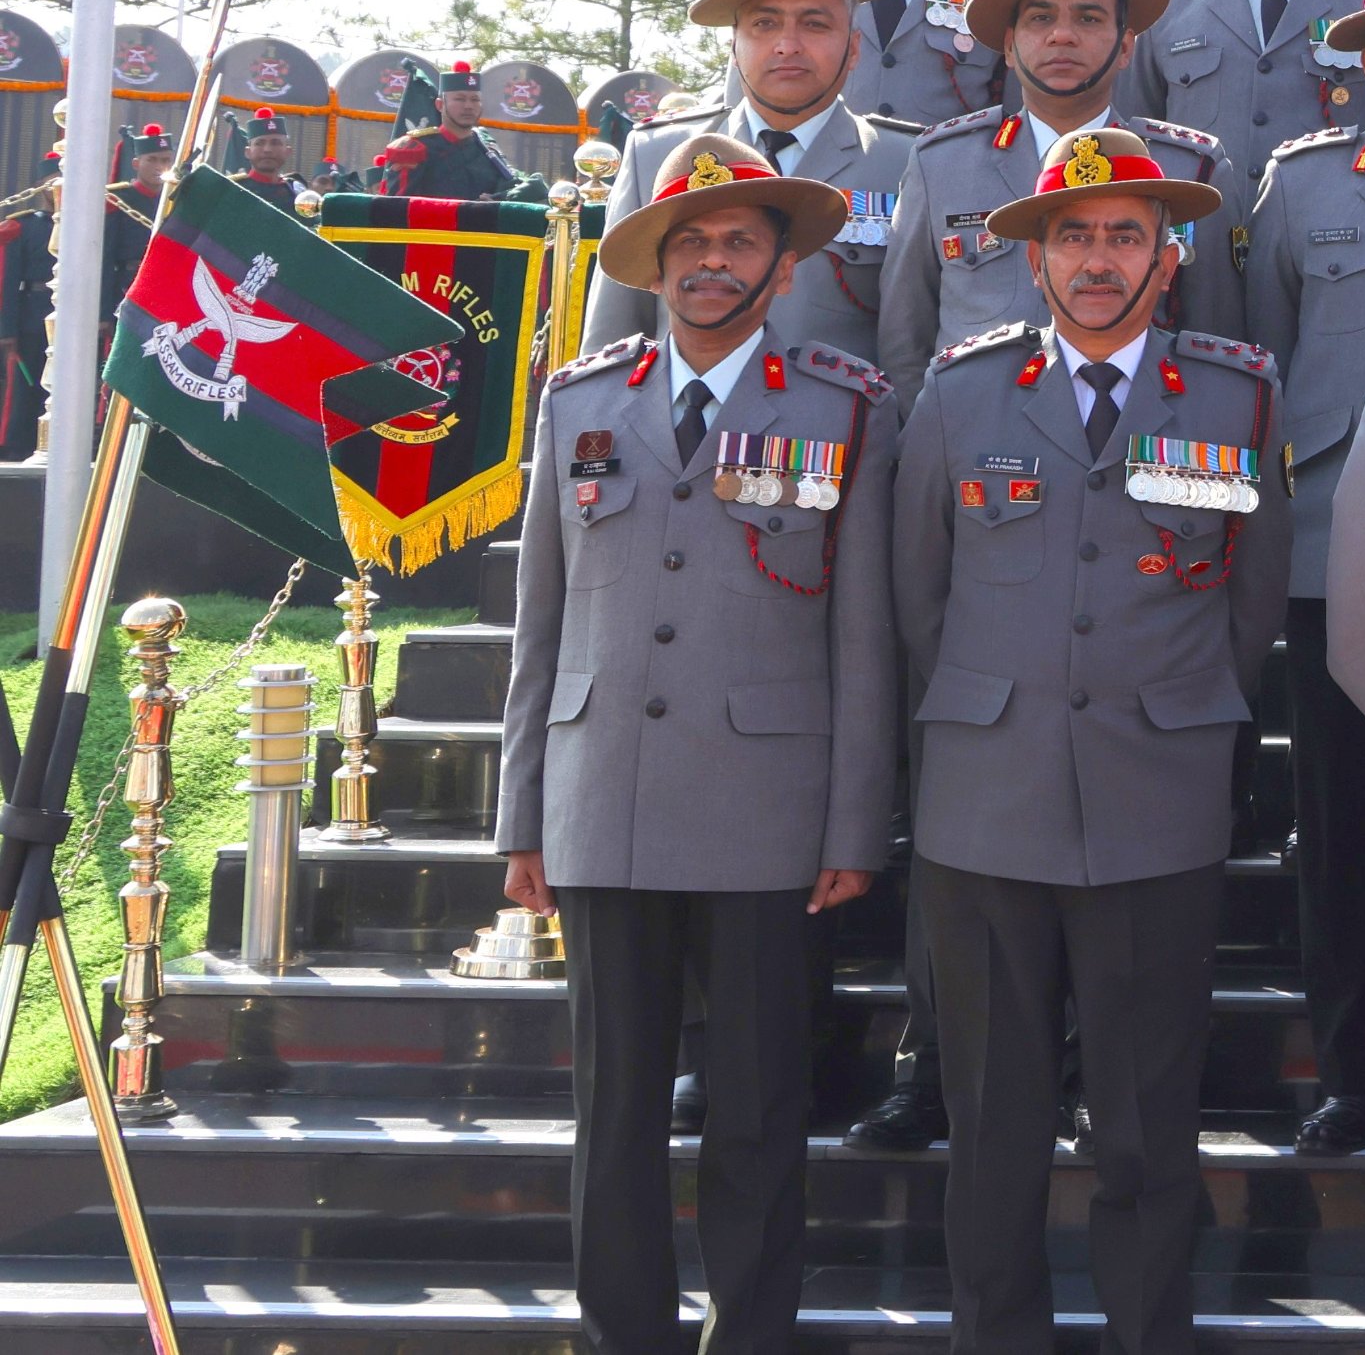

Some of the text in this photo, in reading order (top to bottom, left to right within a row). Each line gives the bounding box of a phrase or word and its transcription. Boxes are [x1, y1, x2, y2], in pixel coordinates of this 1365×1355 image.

[432, 274, 499, 344] RIFLES
[156, 333, 237, 400] ASSAM RIFLES
